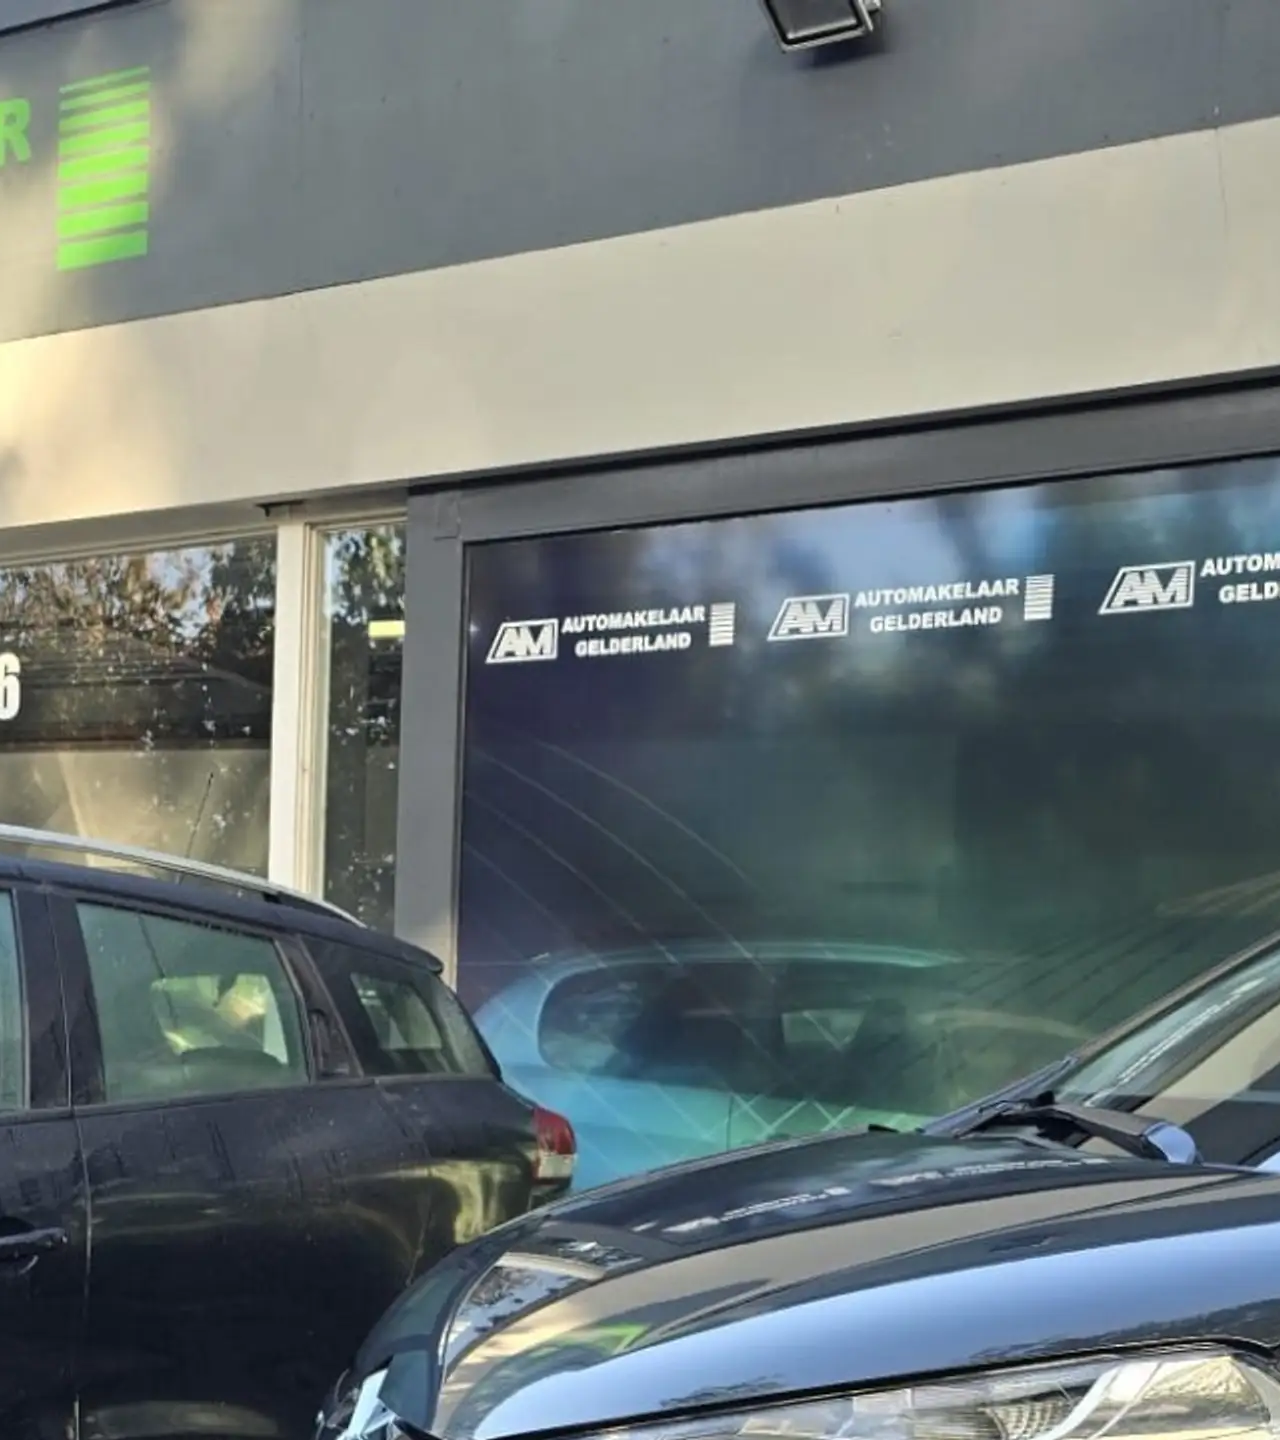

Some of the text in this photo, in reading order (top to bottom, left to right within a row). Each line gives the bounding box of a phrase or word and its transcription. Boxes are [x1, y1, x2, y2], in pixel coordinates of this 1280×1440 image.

[854, 578, 1019, 608] AUTOMAKELAAR
[561, 606, 705, 634] AUTOMAKELAAR
[870, 607, 1002, 634] GELDERLAND
[575, 632, 692, 658] GELDERLAND
